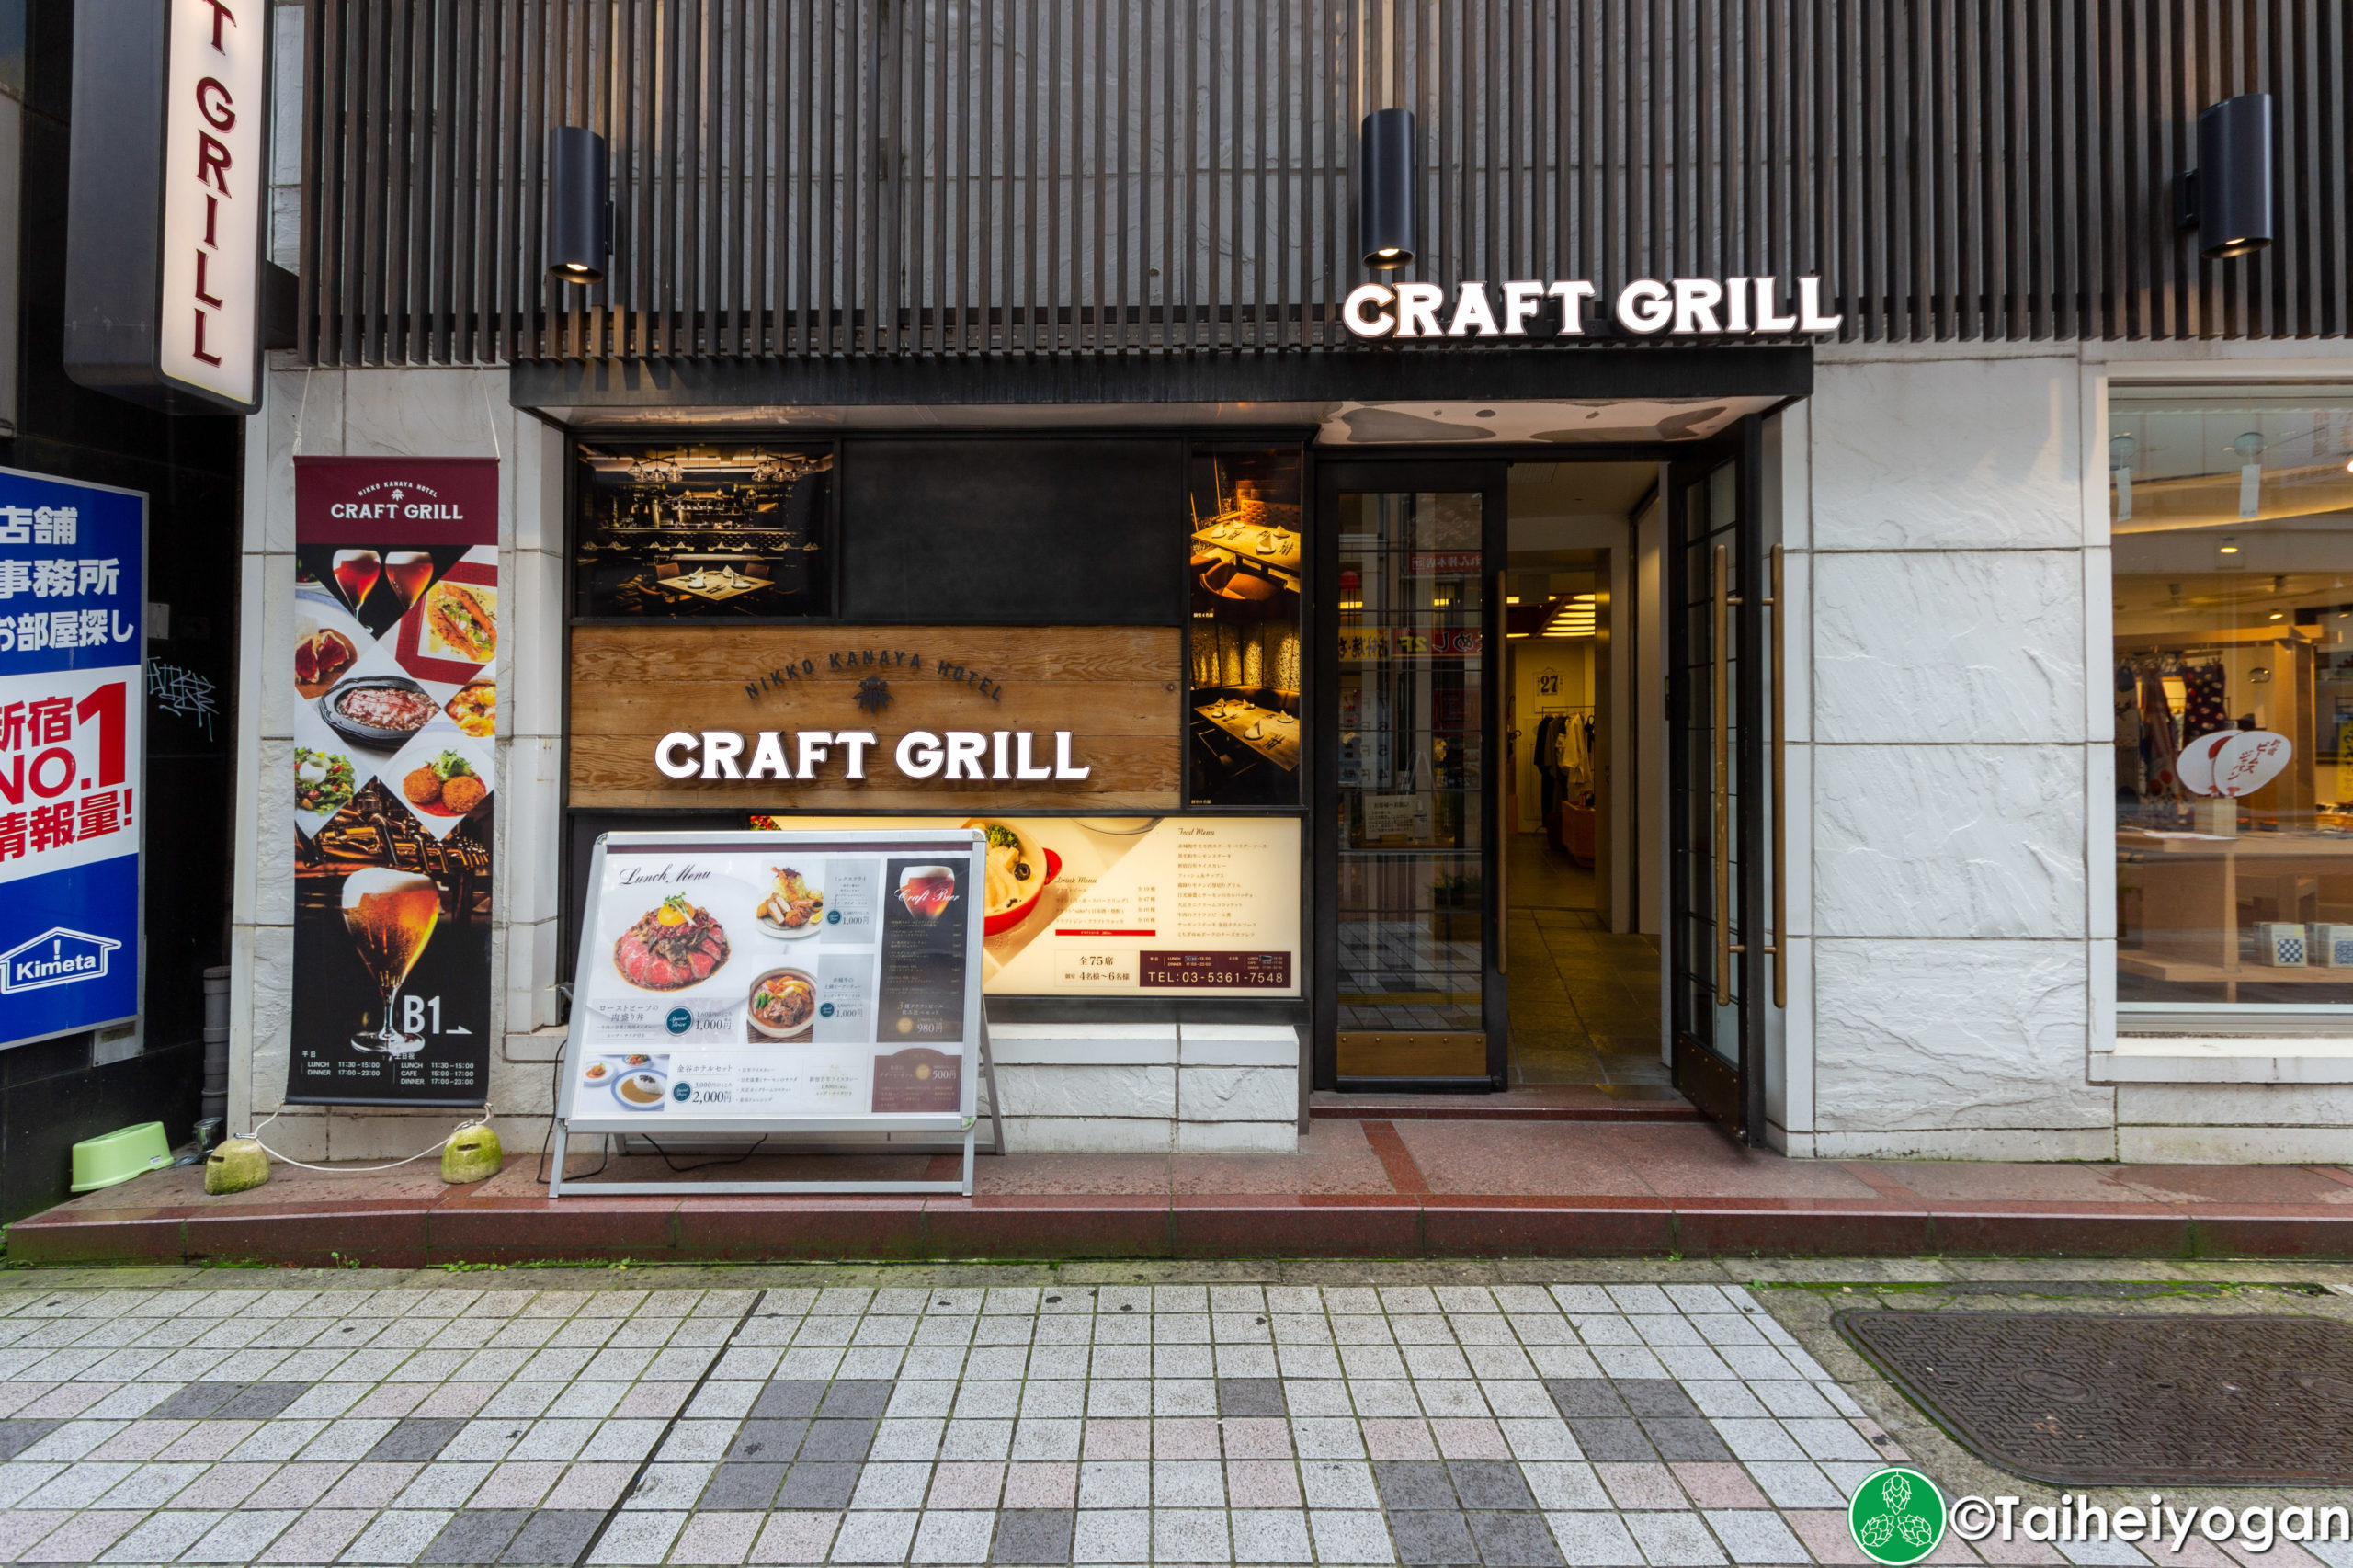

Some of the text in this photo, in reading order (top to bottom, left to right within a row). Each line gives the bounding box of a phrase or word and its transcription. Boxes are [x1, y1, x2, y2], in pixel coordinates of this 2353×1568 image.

[192, 76, 237, 368] GRILL
[1343, 276, 1844, 338] CRAFT GRILL
[358, 483, 381, 497] NIKKO
[416, 484, 438, 498] HOTEL
[0, 506, 78, 545] 店舗
[331, 504, 463, 519] CRAFT GRILL
[0, 558, 119, 599] 事務所
[0, 609, 134, 652] お部屋探し
[745, 650, 1002, 702] NIKKO KANAYA HOTEL
[1540, 675, 1559, 693] 27
[0, 696, 73, 751] 新宿
[654, 731, 1092, 781] CRAFT GRILL
[619, 864, 712, 885] Lunch Menu
[894, 888, 960, 903] Craft Beer
[17, 953, 96, 981] Kimeta
[1080, 956, 1114, 966] 全75席
[404, 995, 440, 1034] B1
[696, 1019, 732, 1030] 1,000円
[692, 1090, 732, 1104] 2,000円
